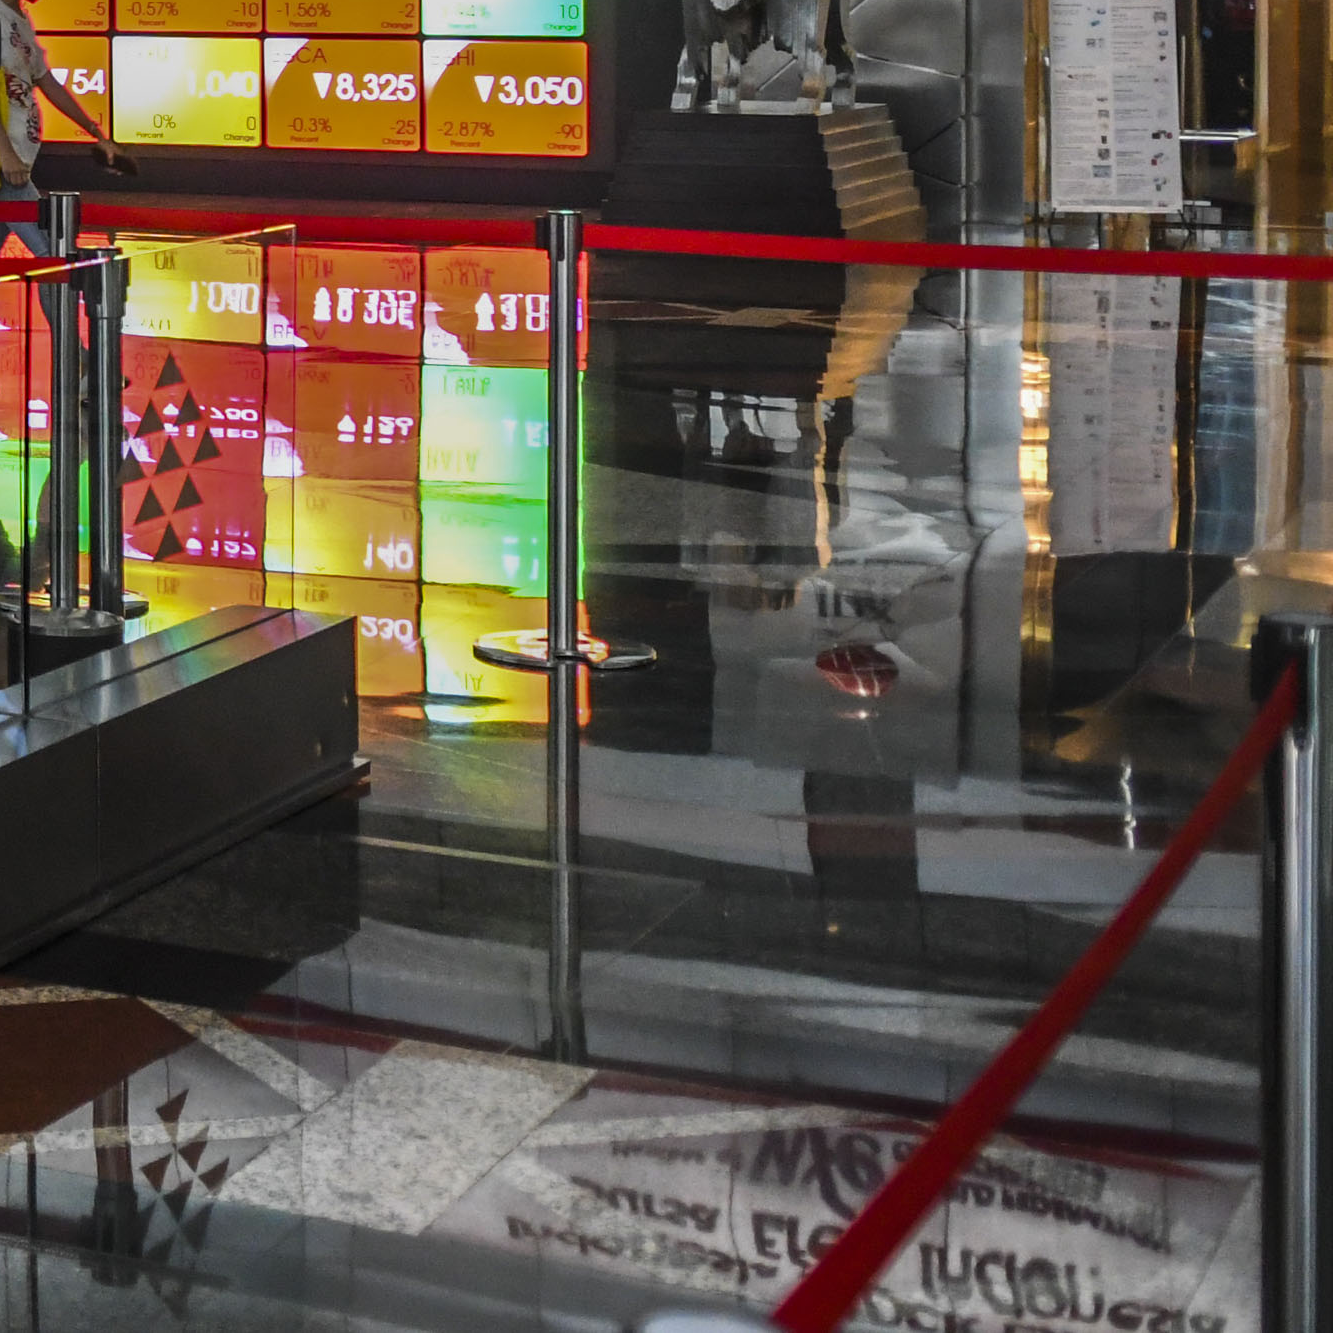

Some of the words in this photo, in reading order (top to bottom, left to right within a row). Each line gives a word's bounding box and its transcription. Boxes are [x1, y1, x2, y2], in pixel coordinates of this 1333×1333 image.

[90, 2, 106, 16] -5
[126, 2, 179, 16] -0.57%
[233, 2, 259, 17] -10
[276, 2, 331, 17] -1.56%
[398, 3, 415, 18] -2
[559, 4, 579, 20] 10
[74, 19, 104, 27] Change
[226, 20, 257, 28] Change
[381, 21, 414, 30] Change
[543, 22, 577, 32] Change
[72, 69, 106, 95] 54
[185, 70, 259, 98] 1,040
[336, 72, 417, 102] 8,325
[498, 75, 583, 106] 3,050
[153, 114, 176, 129] 0%
[246, 116, 257, 131] 0
[288, 117, 332, 132] -0.3%
[389, 120, 417, 135] -25
[437, 121, 495, 137] -2.87%
[555, 124, 583, 139] -90
[224, 134, 255, 142] Change
[382, 138, 415, 147] Change
[547, 142, 581, 151] Change
